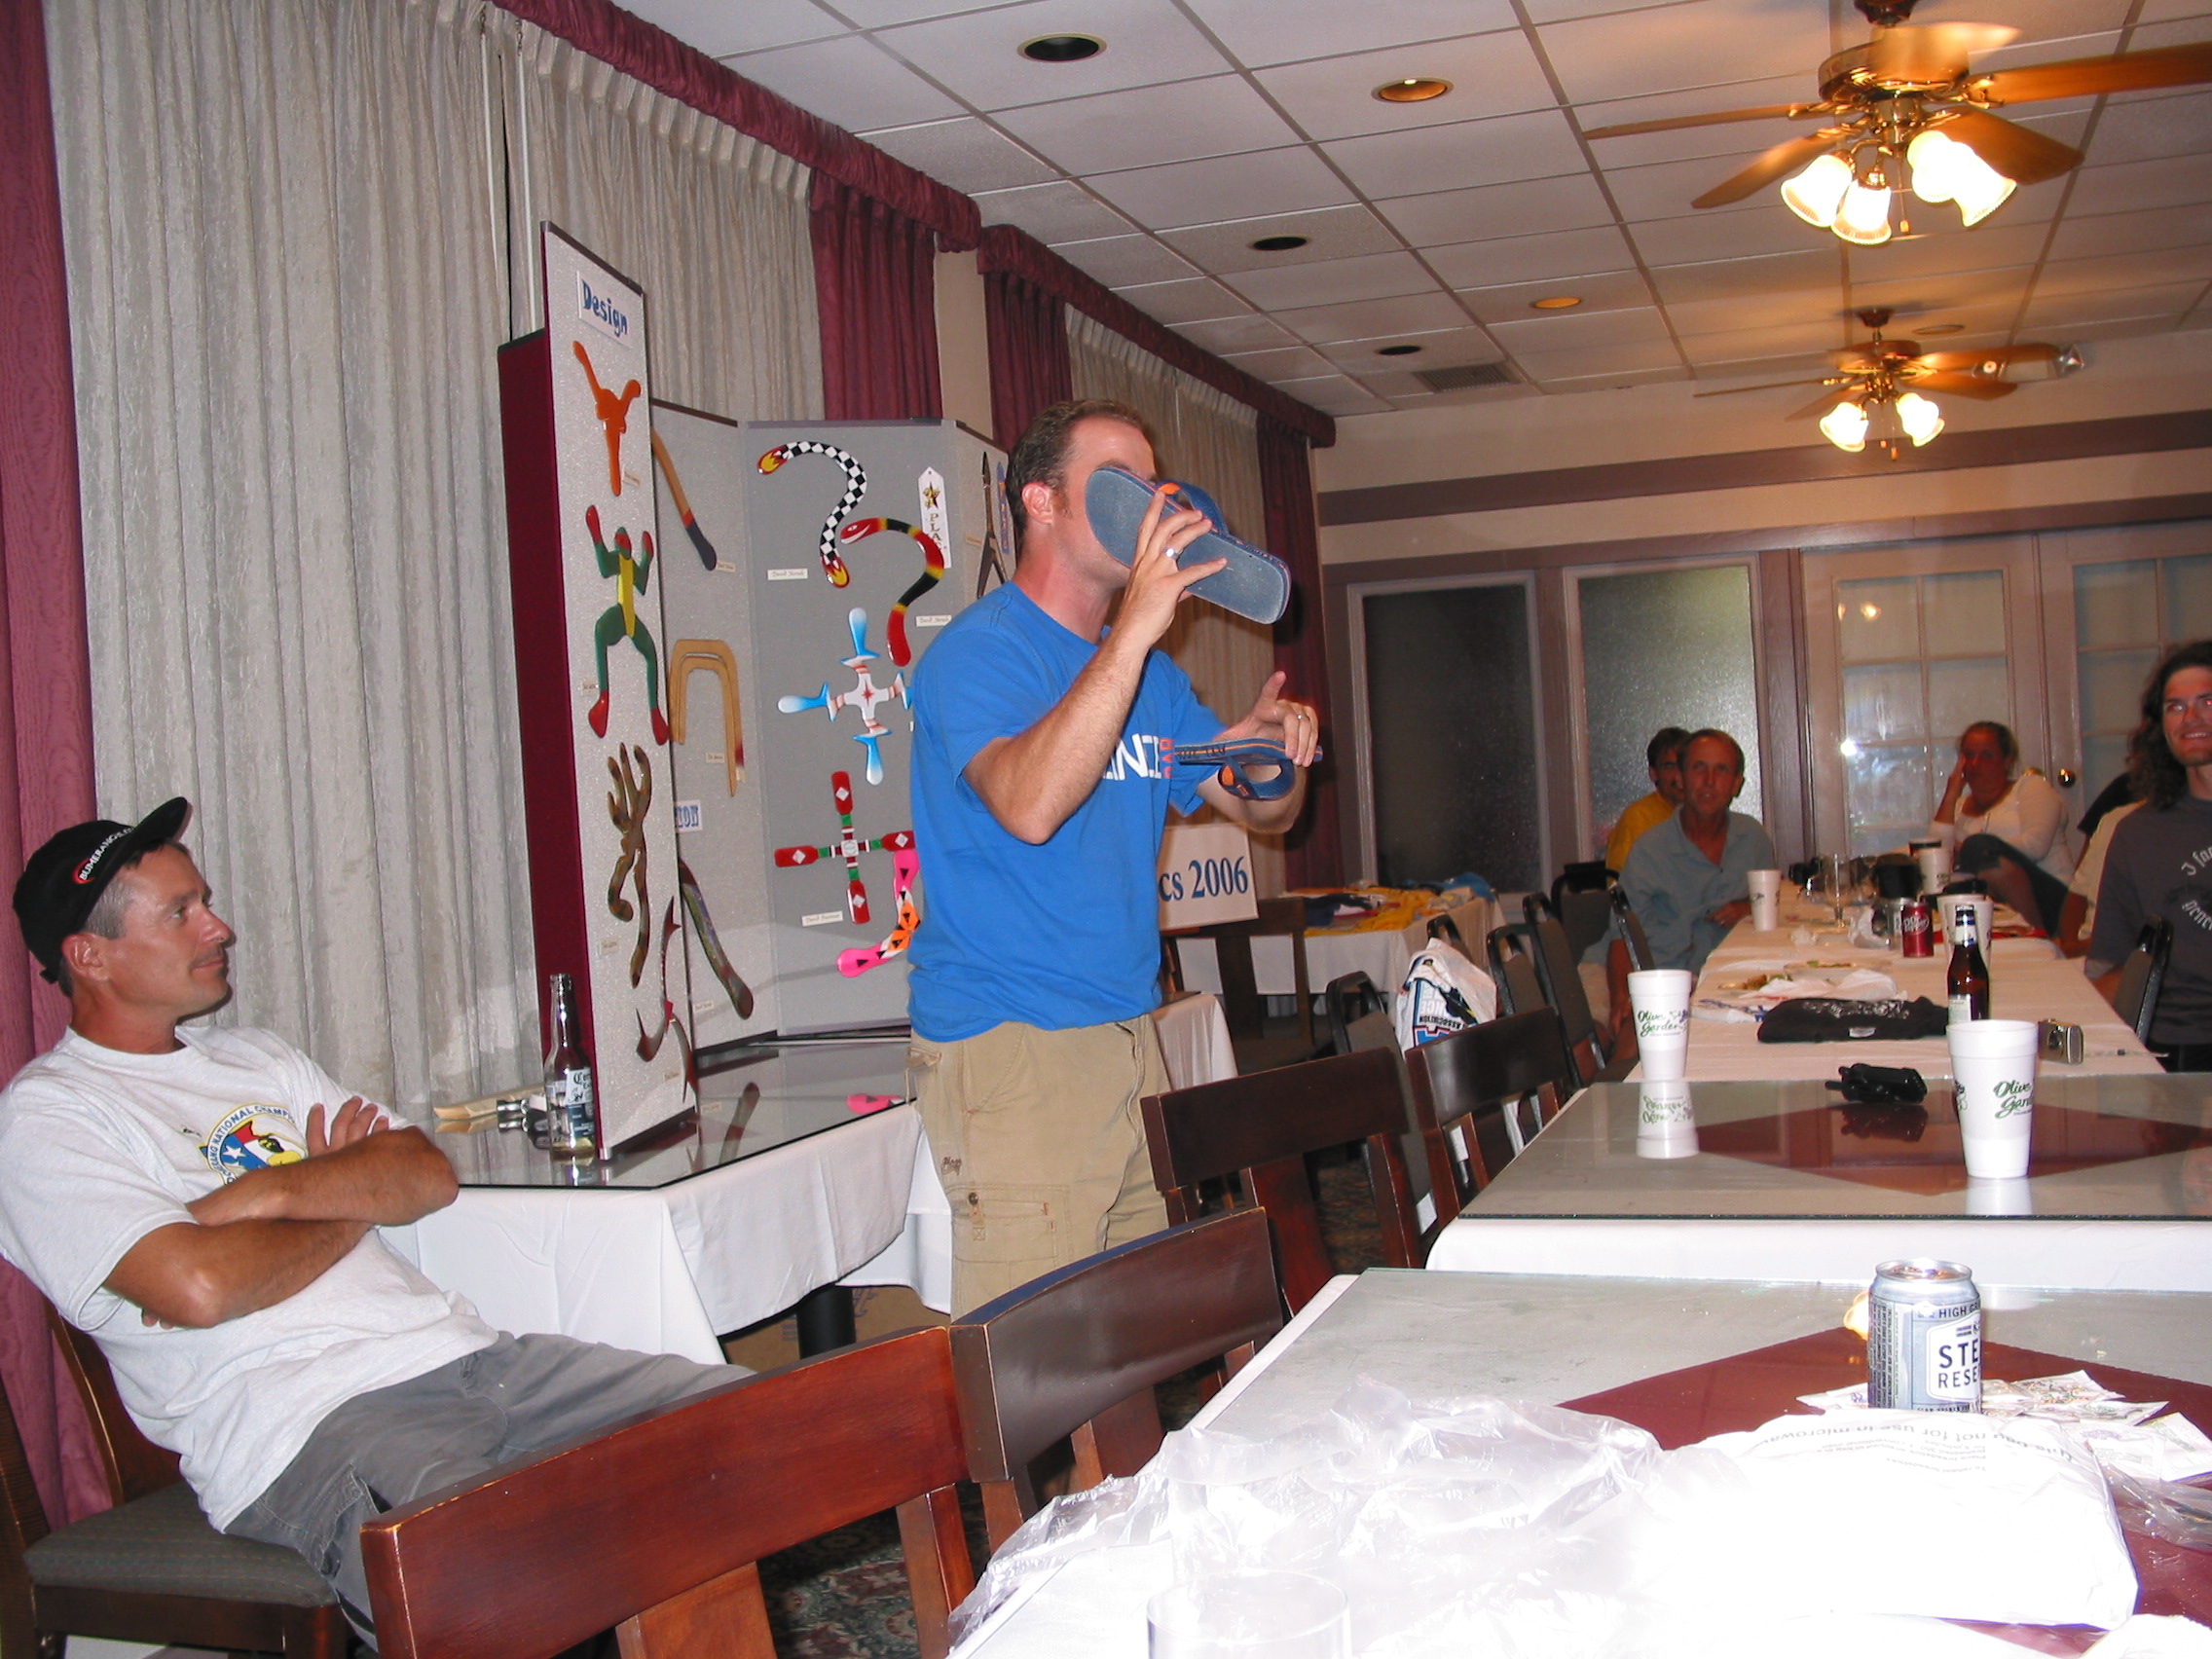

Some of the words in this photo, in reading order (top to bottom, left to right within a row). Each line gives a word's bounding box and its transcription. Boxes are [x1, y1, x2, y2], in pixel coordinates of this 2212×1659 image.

[581, 278, 628, 337] Design
[1188, 856, 1248, 899] 2006
[1993, 1080, 2032, 1098] Olive
[215, 1107, 253, 1145] NATIONAL
[1938, 1307, 1967, 1319] HIGH
[1921, 1428, 1947, 1441] for
[1955, 1432, 1986, 1442] not
